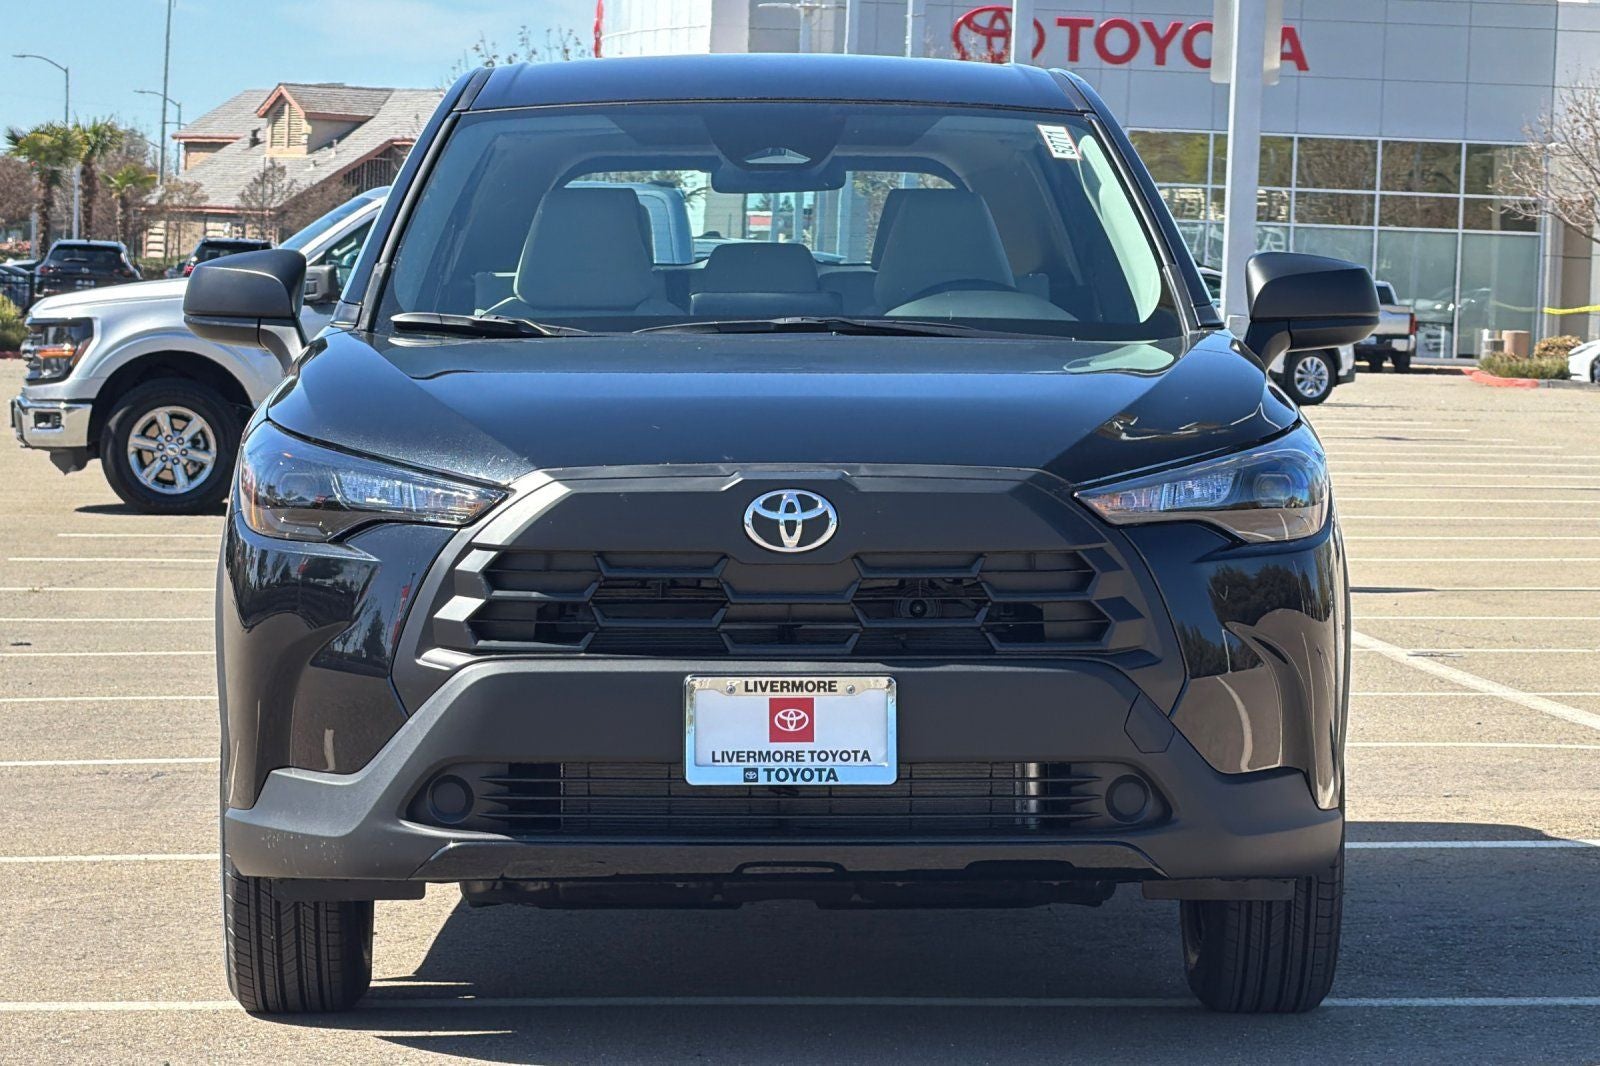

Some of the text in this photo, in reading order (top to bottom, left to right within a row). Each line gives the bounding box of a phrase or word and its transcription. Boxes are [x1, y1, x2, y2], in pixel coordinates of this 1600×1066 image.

[1057, 18, 1309, 71] TOYOA
[1044, 129, 1076, 156] 52771
[744, 680, 838, 693] LIVERMORE
[711, 750, 872, 763] LIVERMORE TOYOTA
[763, 767, 839, 783] TOYOTA
